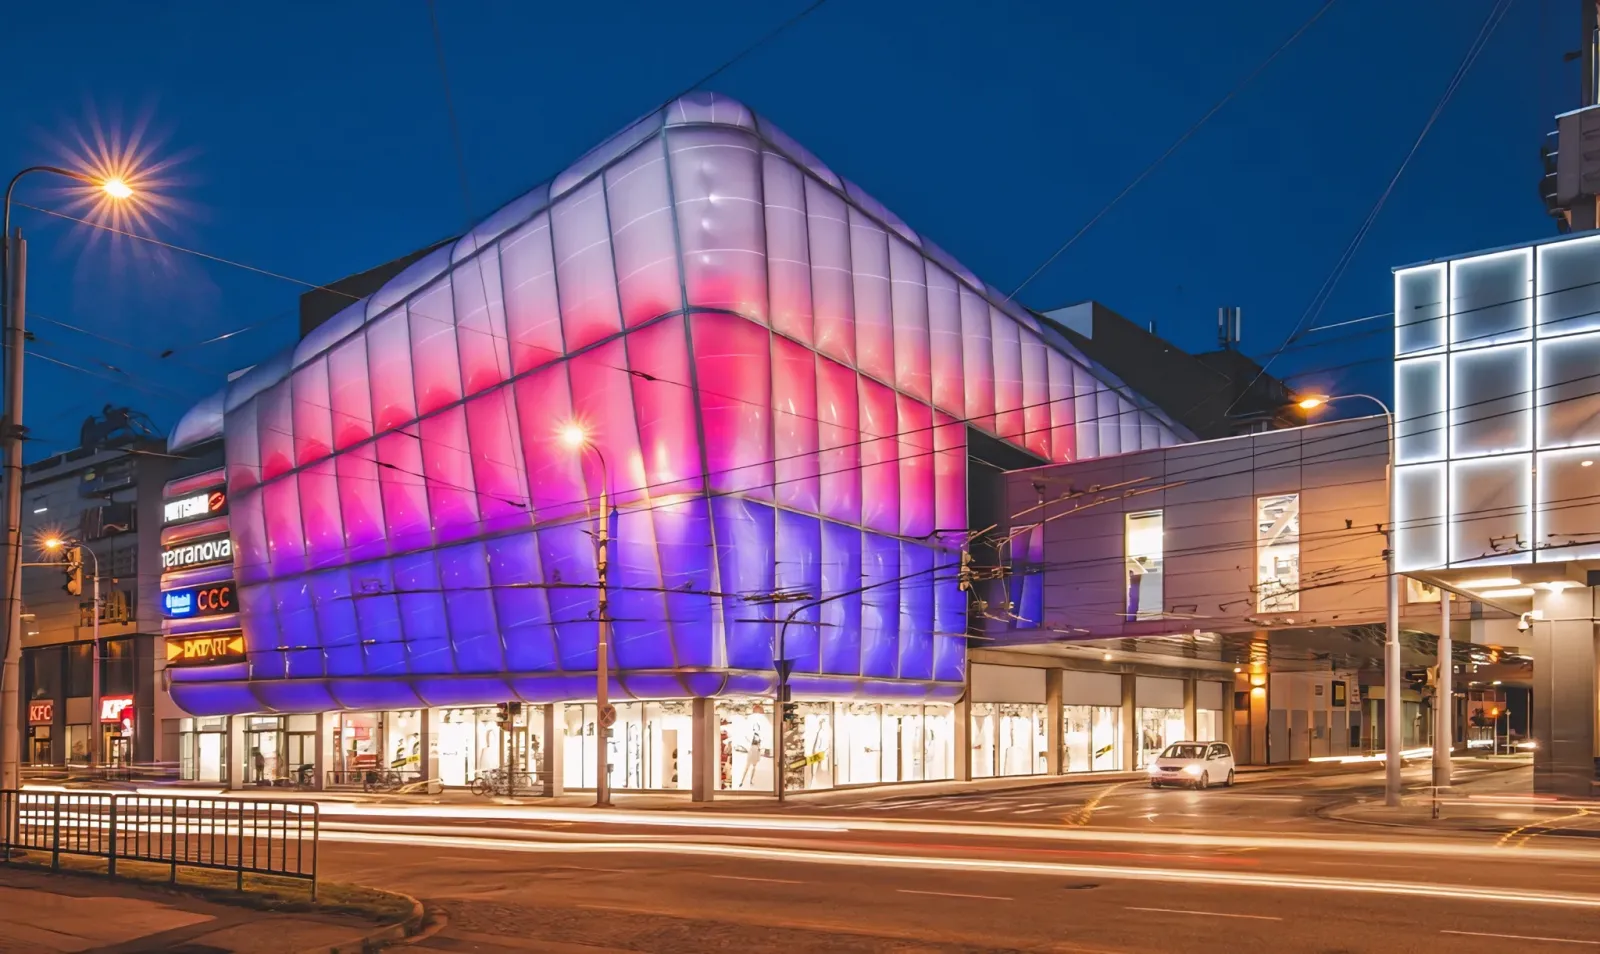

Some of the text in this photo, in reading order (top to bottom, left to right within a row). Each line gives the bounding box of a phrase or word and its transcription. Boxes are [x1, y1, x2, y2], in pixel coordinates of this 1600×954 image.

[197, 587, 229, 610] CCC
[184, 637, 230, 657] DATART
[30, 704, 51, 721] KFC
